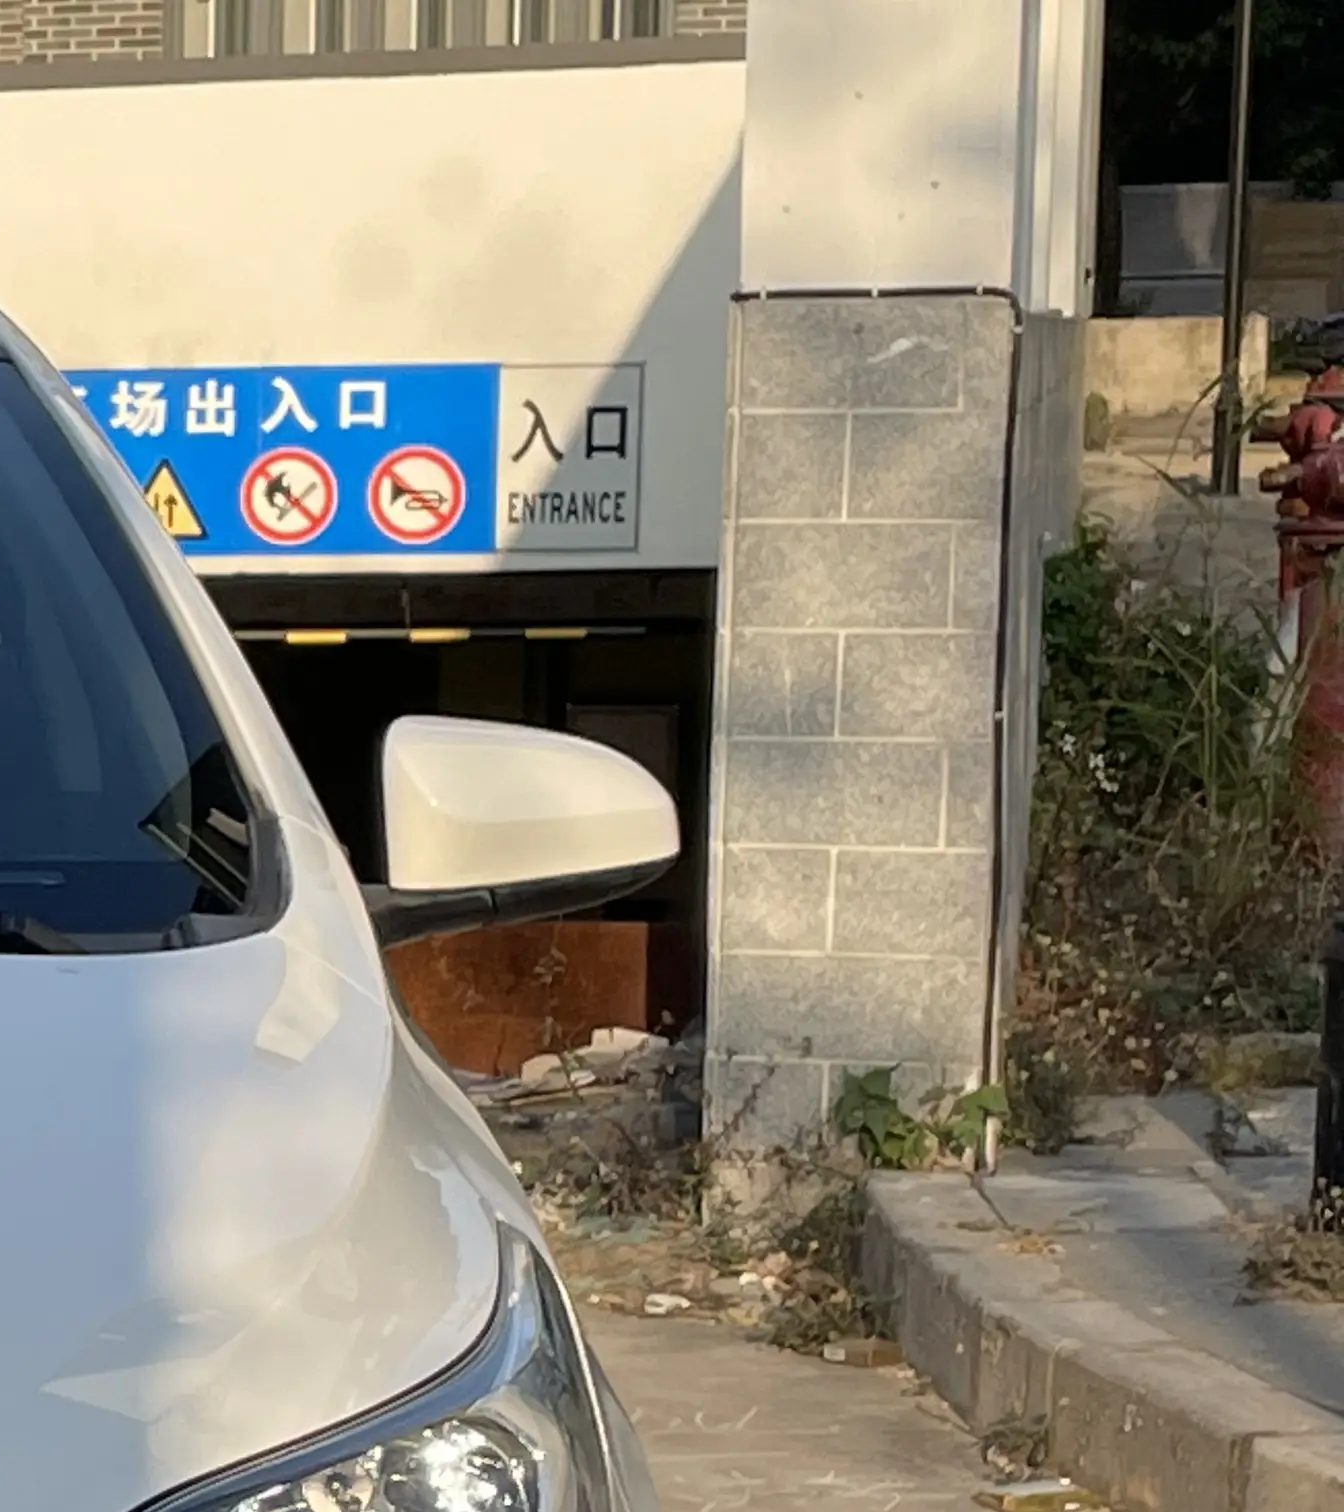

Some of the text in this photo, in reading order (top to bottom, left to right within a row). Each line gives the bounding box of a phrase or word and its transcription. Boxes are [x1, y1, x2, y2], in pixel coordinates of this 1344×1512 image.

[71, 377, 388, 437] 场出入口
[511, 399, 628, 462] 入口
[507, 490, 627, 525] ENTRANCE
